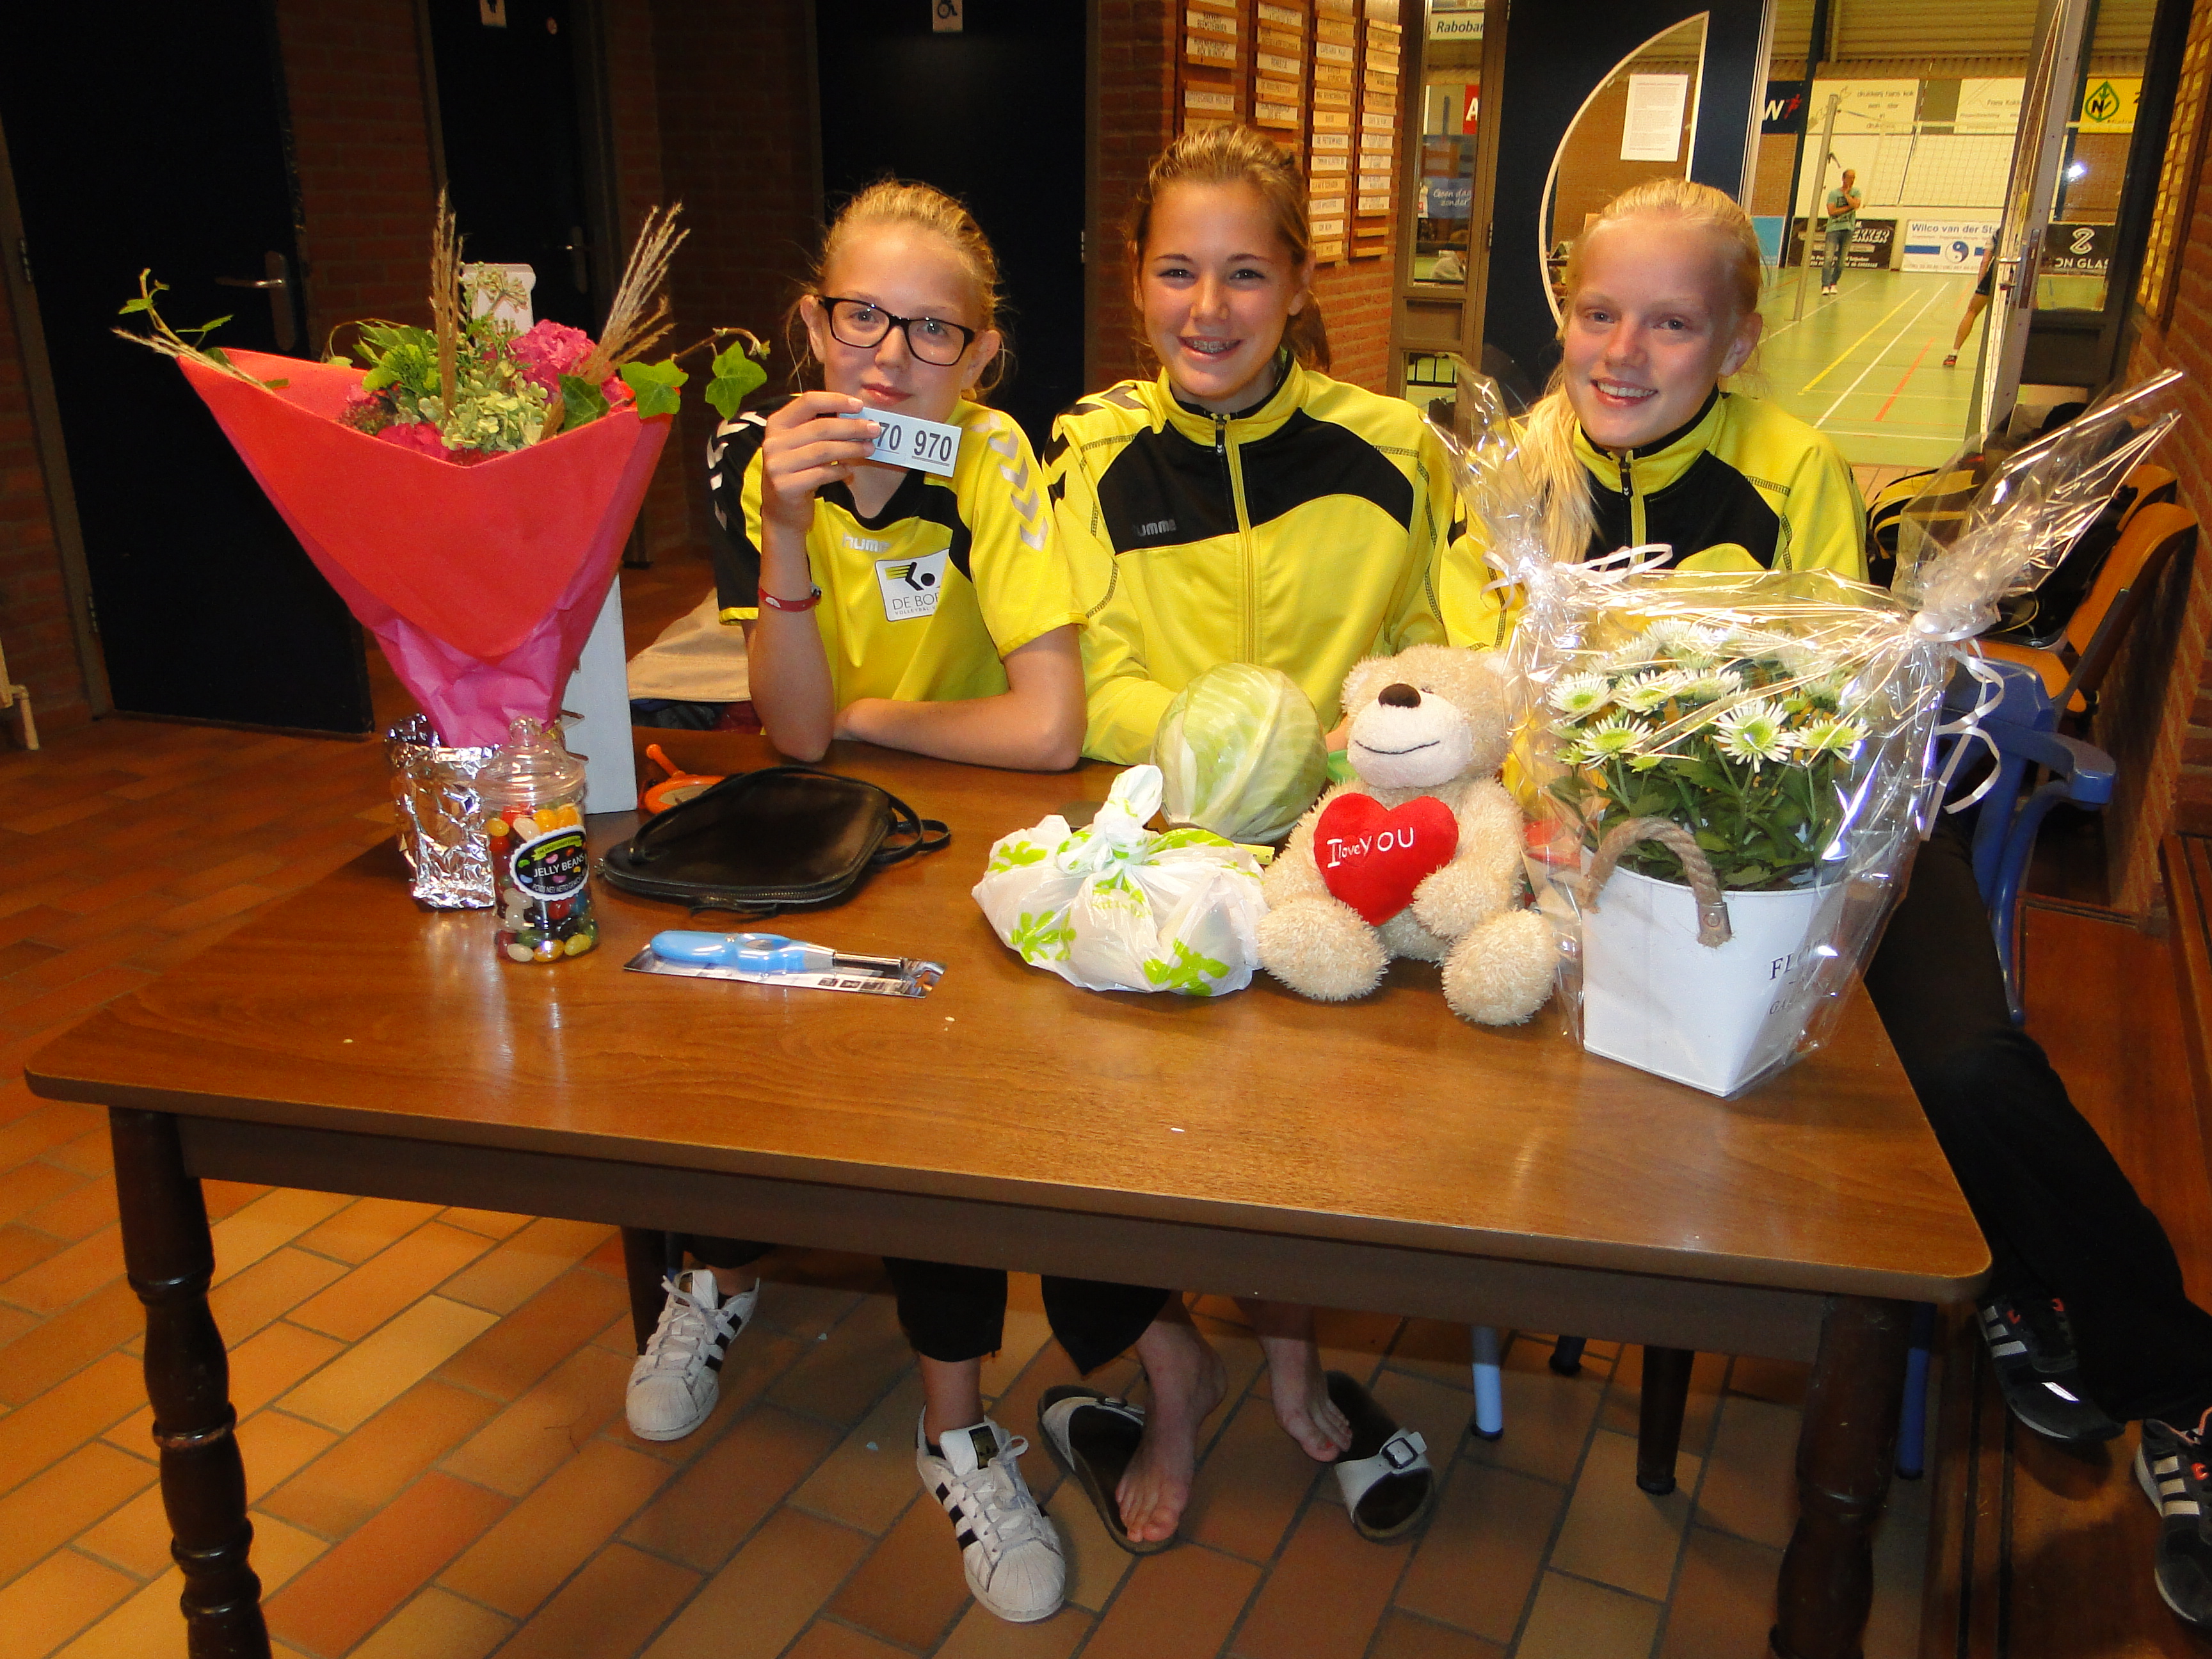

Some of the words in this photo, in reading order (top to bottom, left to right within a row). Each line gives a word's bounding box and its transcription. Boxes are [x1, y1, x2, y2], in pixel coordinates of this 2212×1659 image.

[1912, 223, 1939, 232] Wilco
[1942, 225, 1959, 234] van
[1962, 225, 1978, 234] der
[914, 430, 952, 461] 970
[892, 598, 911, 611] DE
[895, 607, 930, 615] VOLLEYBAL
[534, 864, 560, 878] JELLY
[561, 853, 585, 871] BEANS
